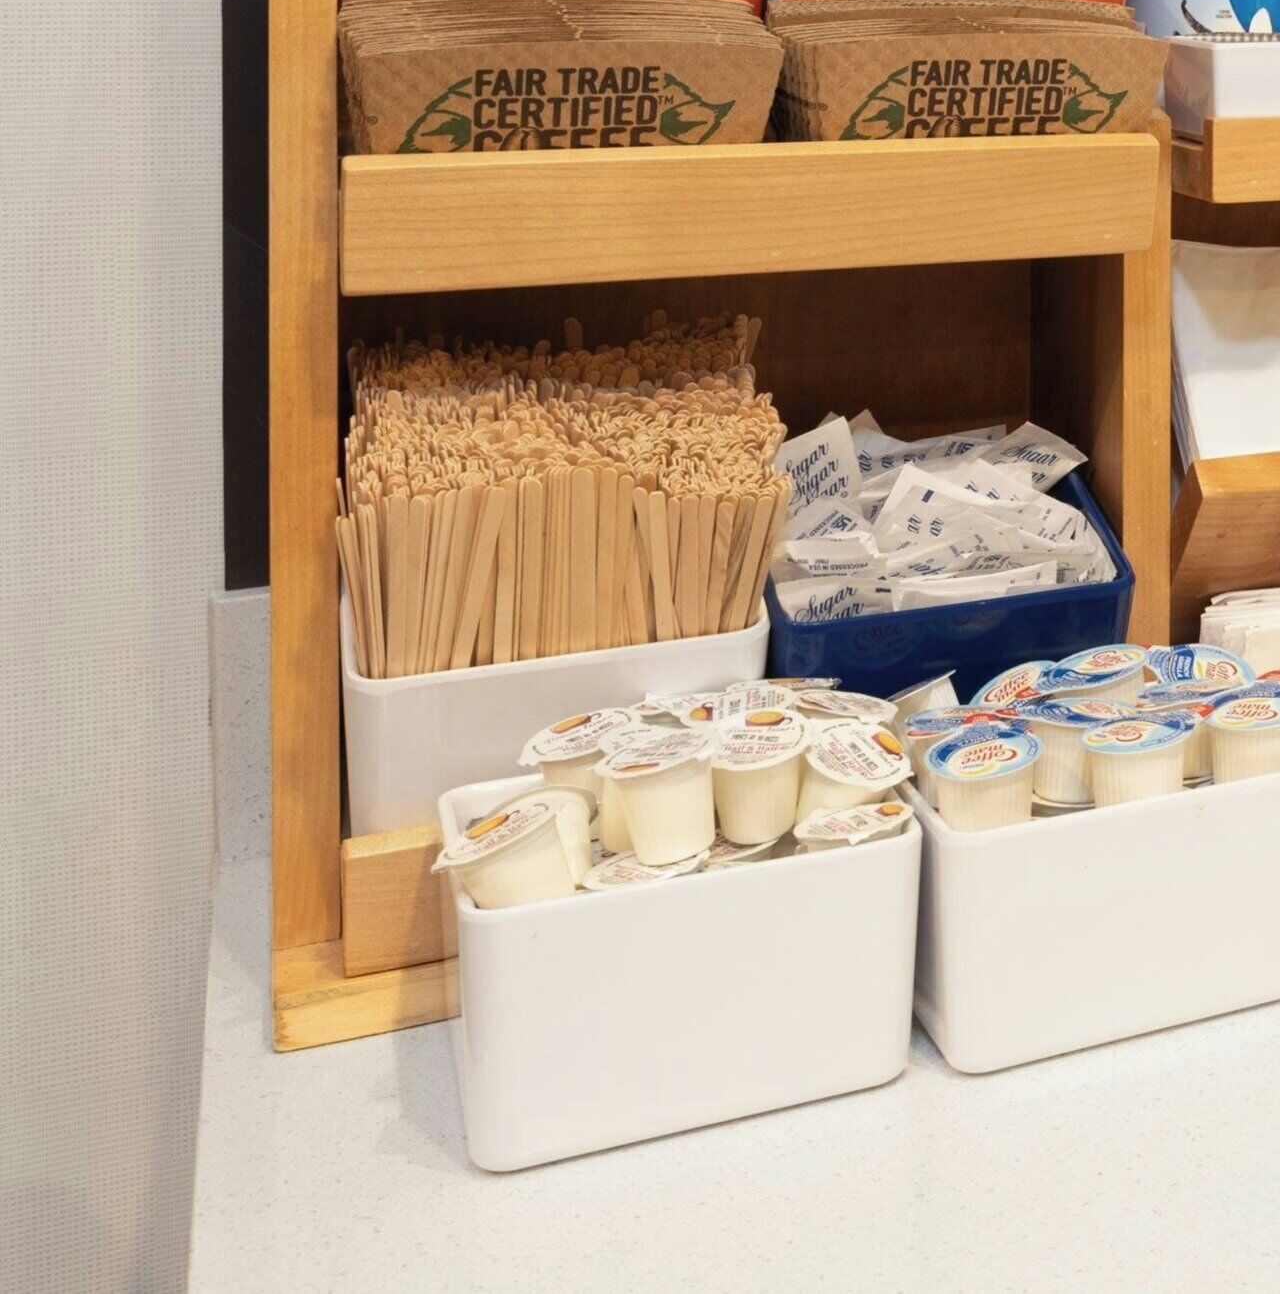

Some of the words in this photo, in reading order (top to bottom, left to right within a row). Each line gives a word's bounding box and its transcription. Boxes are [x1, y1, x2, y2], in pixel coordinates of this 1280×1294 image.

[474, 69, 546, 96] FAIR
[558, 66, 661, 94] TRADE
[910, 60, 970, 86] FAIR
[980, 58, 1068, 85] TRADE
[829, 562, 868, 571] PROCESSED
[794, 586, 858, 622] Sugar
[984, 671, 1030, 703] Coffee
[1226, 709, 1279, 722] Coffee
[961, 747, 1018, 766] Coffee
